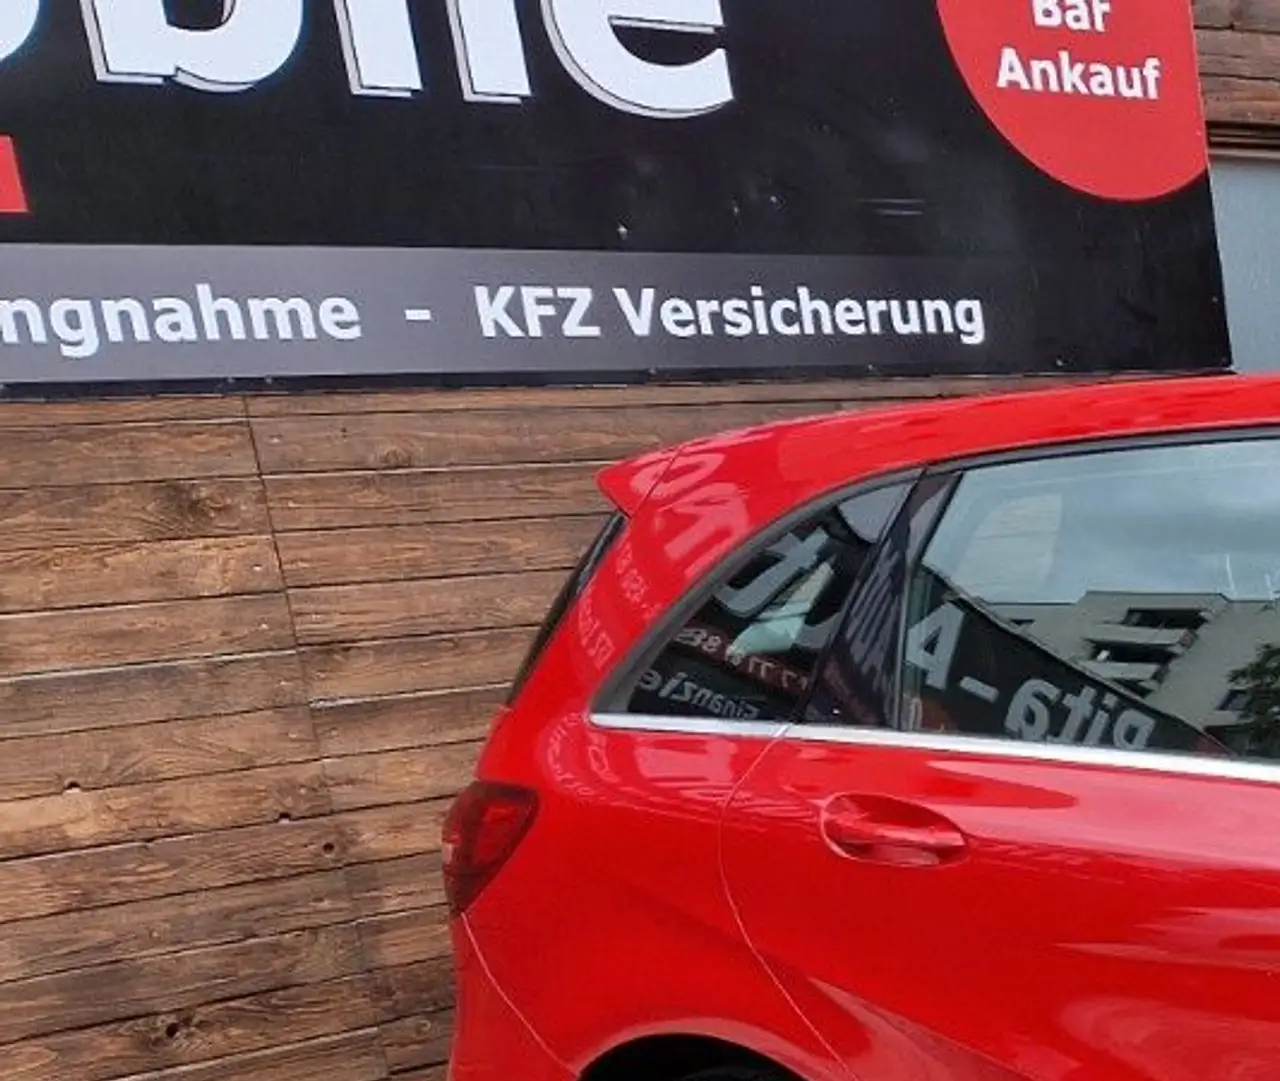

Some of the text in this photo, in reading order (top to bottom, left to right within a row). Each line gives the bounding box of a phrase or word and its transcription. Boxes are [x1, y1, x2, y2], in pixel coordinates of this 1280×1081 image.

[1031, 0, 1111, 32] Bar
[996, 46, 1162, 99] Ankauf
[0, 283, 363, 358] ngnahme
[474, 285, 601, 338] KFZ
[612, 285, 986, 345] Versicherung
